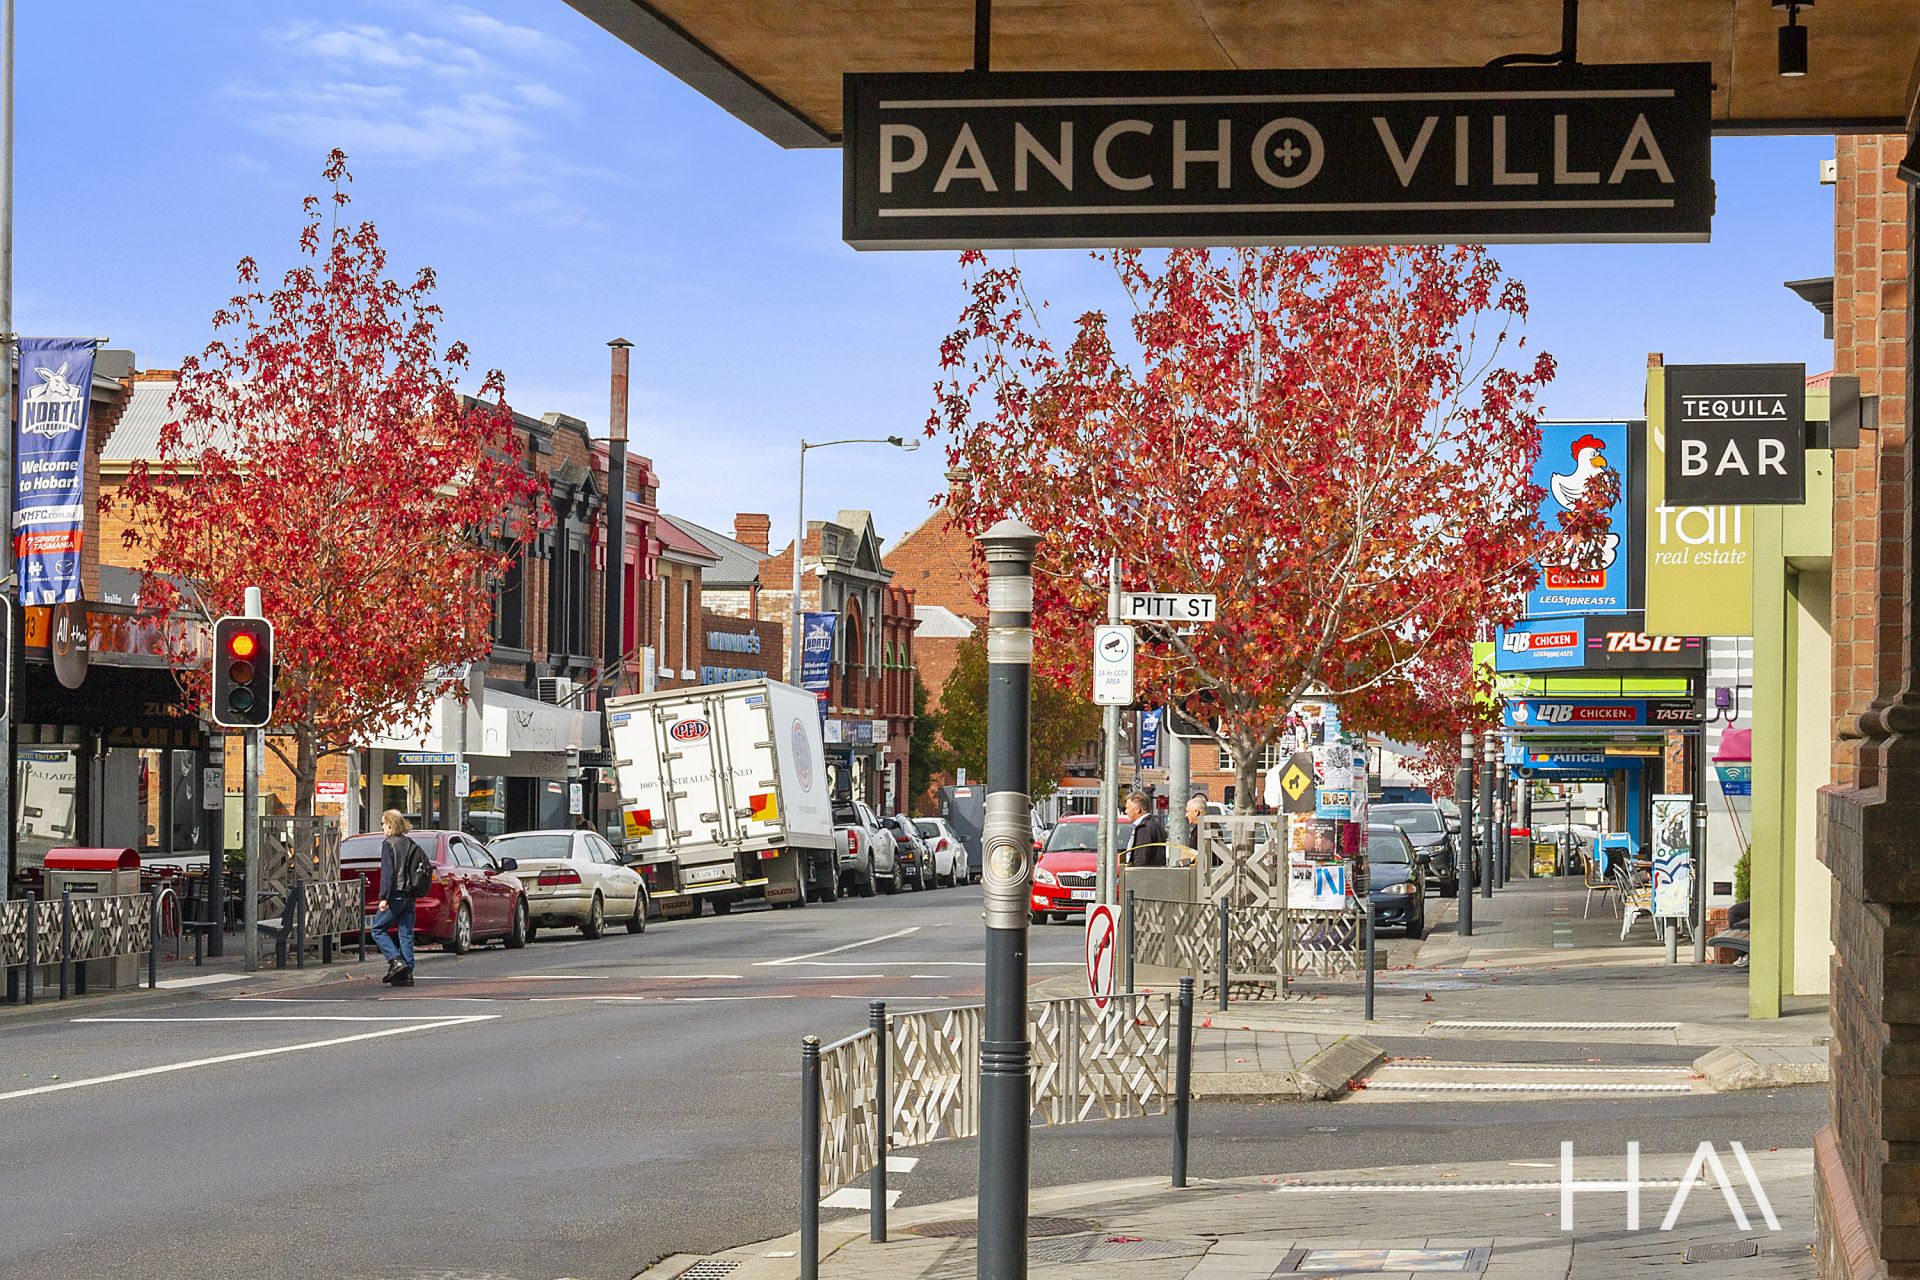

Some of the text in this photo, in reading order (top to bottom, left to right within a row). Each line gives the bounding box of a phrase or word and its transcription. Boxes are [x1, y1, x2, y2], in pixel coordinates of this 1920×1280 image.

[879, 113, 1676, 193] PANCHO VILLA
[26, 400, 81, 429] NORTH
[1682, 399, 1786, 418] TEQUILA
[1681, 438, 1788, 476] BAR
[21, 459, 79, 475] Welcome
[19, 475, 80, 493] to Hobart
[33, 541, 74, 550] TASMANIA
[1654, 547, 1747, 565] real estate
[1133, 597, 1212, 617] PITT ST
[1534, 636, 1572, 647] CHICKEN
[1605, 632, 1682, 652] TASTE
[1580, 709, 1627, 718] CHICKEN
[1656, 710, 1693, 720] TASTE
[677, 722, 706, 737] PFD
[661, 772, 714, 787] AUSTRALIAN
[767, 888, 797, 896] ISUZU
[661, 901, 691, 909] ISUZU
